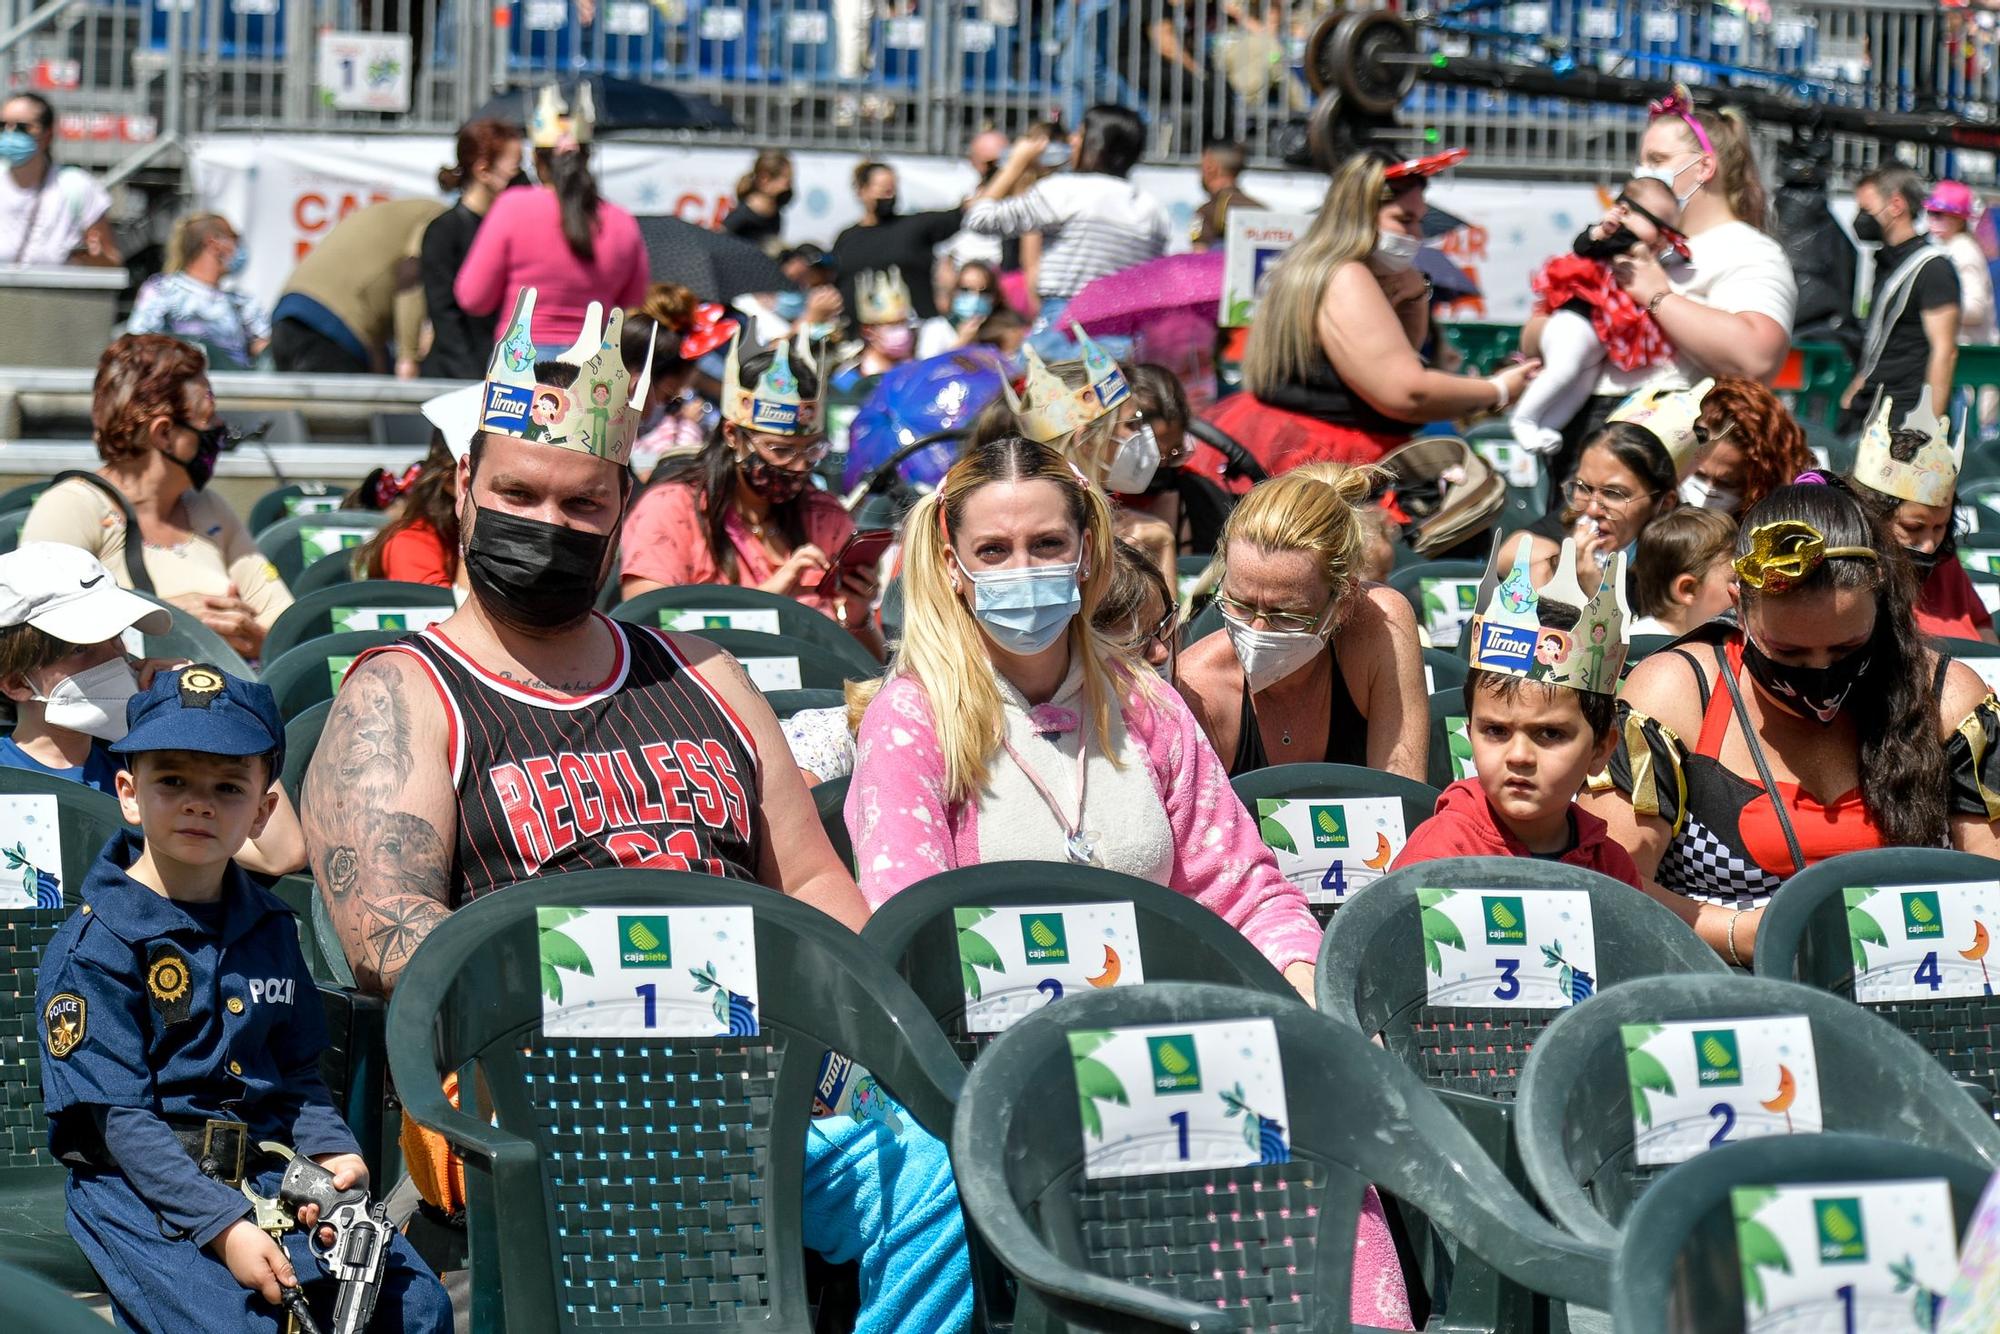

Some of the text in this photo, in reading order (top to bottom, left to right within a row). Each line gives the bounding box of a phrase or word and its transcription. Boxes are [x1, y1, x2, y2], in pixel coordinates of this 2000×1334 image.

[294, 191, 390, 233] CA
[491, 385, 528, 416] Tirma
[757, 401, 797, 422] Tirma
[1486, 625, 1531, 655] Tirma
[489, 739, 751, 876] RECKLESS
[1316, 834, 1346, 844] cajasiete
[1321, 859, 1348, 897] 4
[1489, 929, 1524, 940] cajasiete
[1907, 923, 1940, 934] cajasiete
[623, 951, 668, 963] cajasiete
[1028, 948, 1065, 959] cajasiete
[1493, 959, 1520, 1001] 3
[1914, 951, 1943, 992] 4
[50, 1001, 78, 1021] POLICE
[635, 983, 657, 1029] 1
[1168, 1111, 1189, 1161] 1
[1709, 1102, 1738, 1150] 2
[1836, 1284, 1856, 1334] 1
